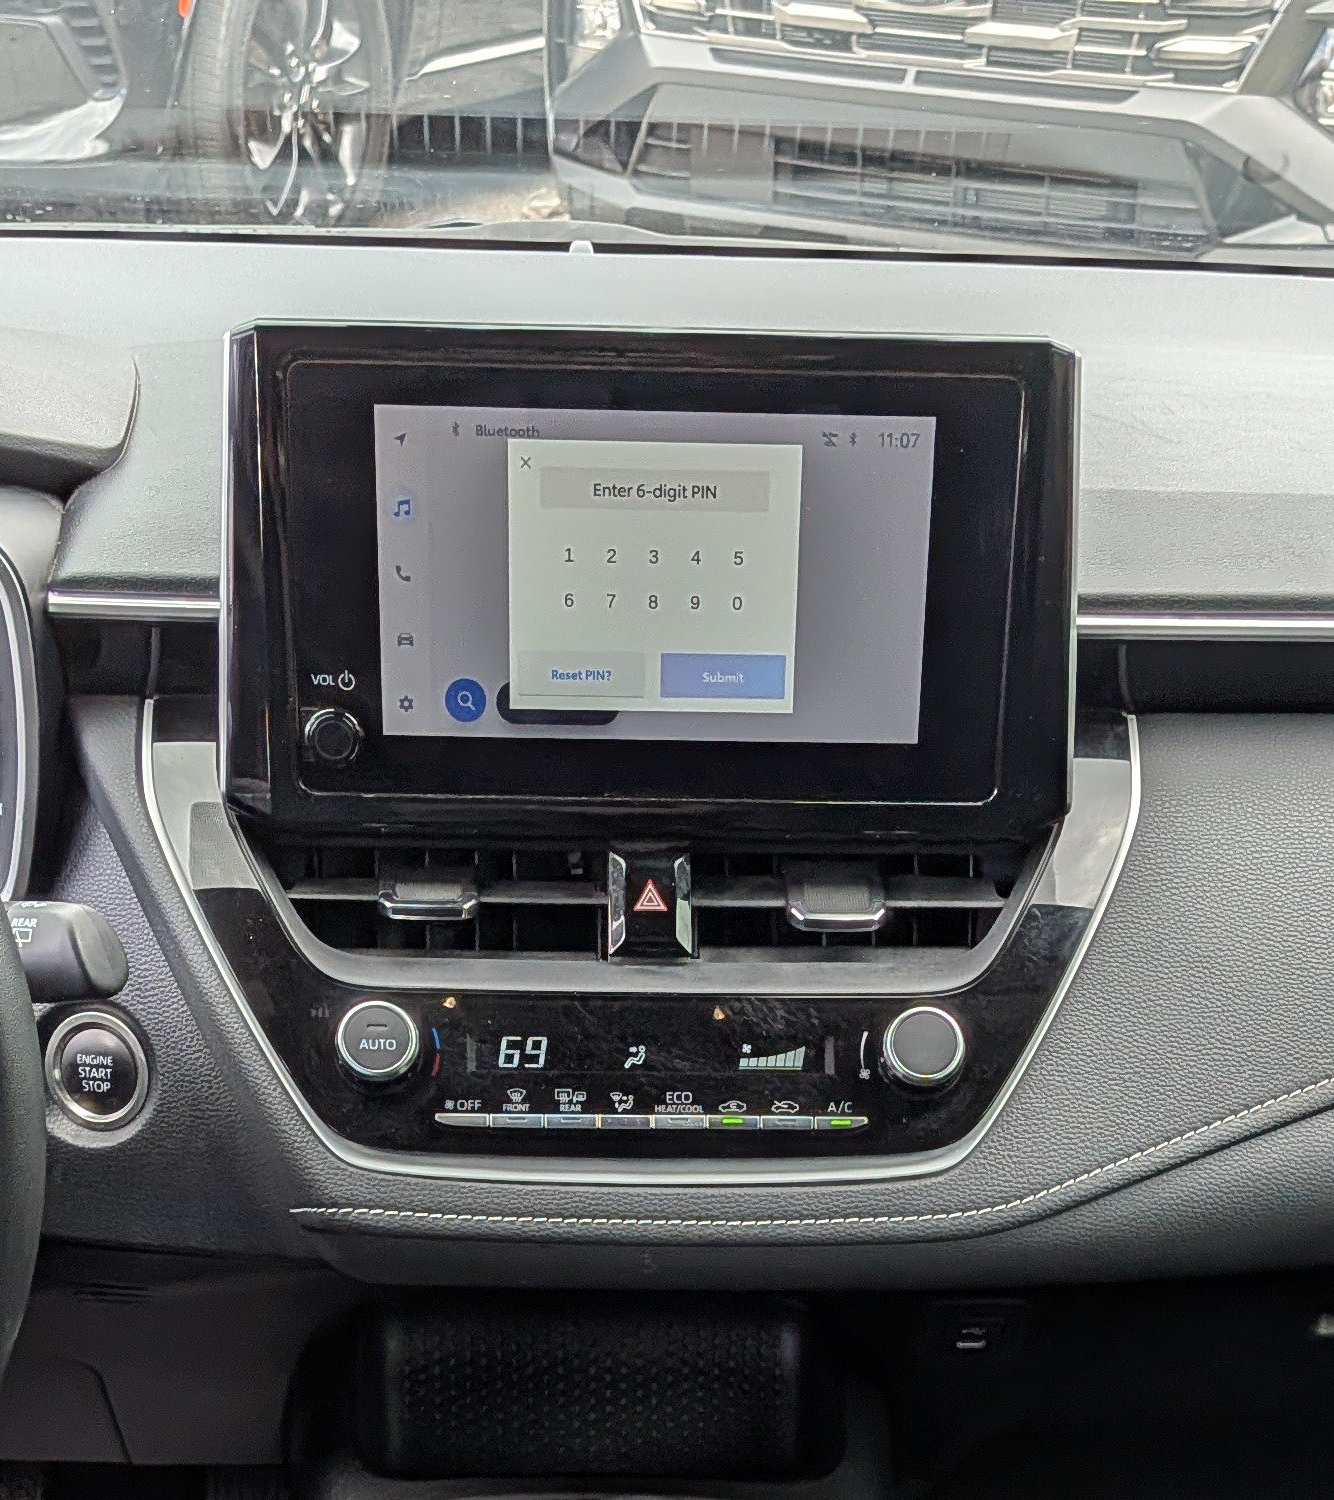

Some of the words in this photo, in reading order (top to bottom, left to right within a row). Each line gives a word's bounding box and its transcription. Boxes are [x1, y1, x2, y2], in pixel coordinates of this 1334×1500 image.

[475, 424, 540, 438] Bluetooth
[879, 432, 920, 448] 11:07
[593, 483, 633, 498] Enter
[636, 484, 687, 502] 6-digit
[691, 486, 717, 499] PIN
[564, 548, 574, 562] 1
[606, 549, 617, 563] 2
[649, 550, 659, 564] 3
[690, 551, 701, 565] 4
[733, 551, 743, 565] 5
[564, 593, 574, 607] 6
[606, 594, 616, 608] 7
[648, 595, 658, 609] 8
[690, 596, 700, 609] 9
[732, 596, 742, 610] 0
[311, 674, 335, 685] VOL
[551, 670, 582, 680] Reset
[585, 671, 611, 681] PIN?
[702, 672, 744, 683] Submit
[11, 918, 37, 927] REAR
[359, 1038, 397, 1050] AUTO
[498, 1036, 548, 1068] 69
[77, 1054, 113, 1066] ENGINE
[78, 1067, 112, 1079] START
[82, 1080, 111, 1092] STOP
[666, 1092, 692, 1103] ECO
[457, 1100, 482, 1111] OFF
[503, 1104, 530, 1112] FRONT
[559, 1104, 581, 1112] REAR
[655, 1105, 704, 1113] HEAT/COOL
[827, 1102, 853, 1113] A/C
